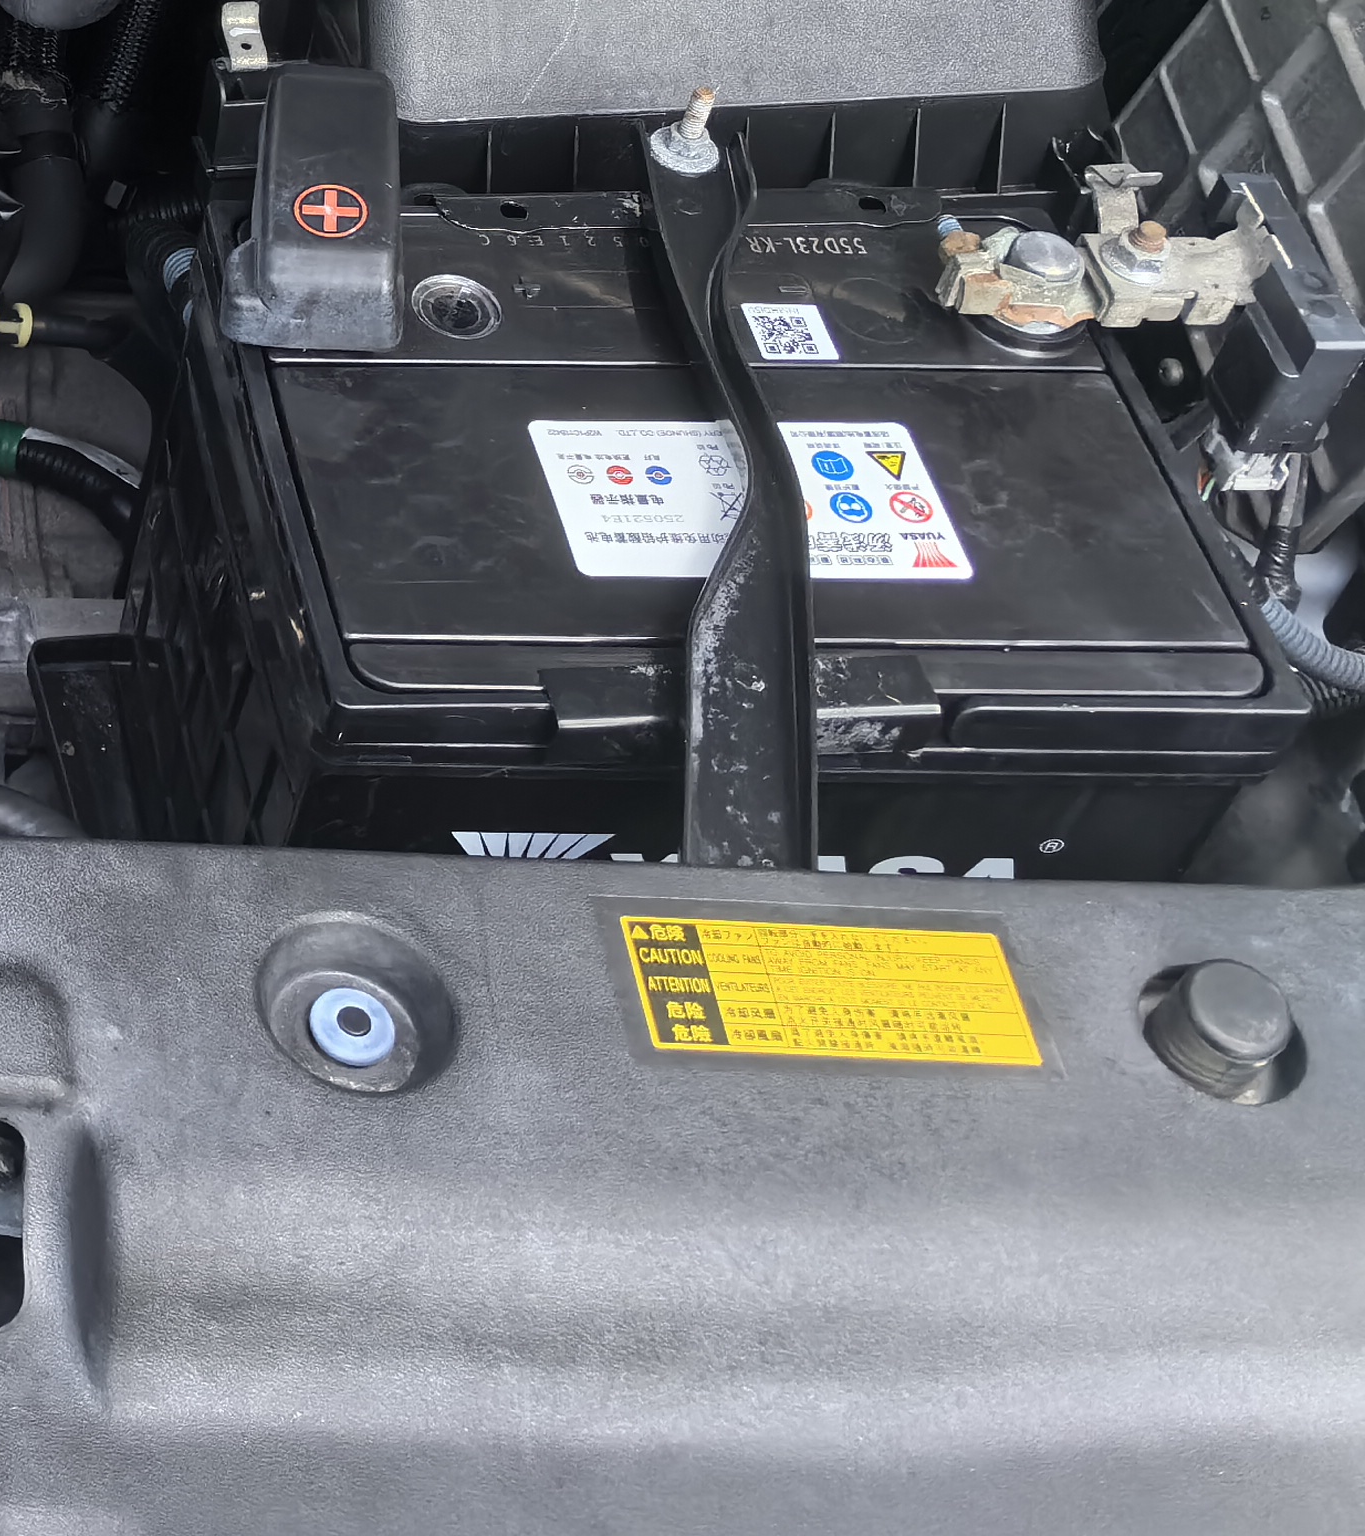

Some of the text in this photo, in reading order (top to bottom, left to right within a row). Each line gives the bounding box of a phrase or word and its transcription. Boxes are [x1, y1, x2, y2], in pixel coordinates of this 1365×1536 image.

[746, 236, 868, 254] 55D23L-KR
[589, 493, 665, 506] 电量指示器
[601, 514, 684, 523] 250521E4
[584, 531, 729, 544] 动用免维护铅酸蓄电池
[899, 532, 946, 541] YUASA
[649, 924, 686, 942] 危険
[639, 947, 704, 966] CAUTION
[647, 976, 711, 994] ATTENTION
[665, 1000, 706, 1021] 危险
[672, 1024, 713, 1043] 危險
